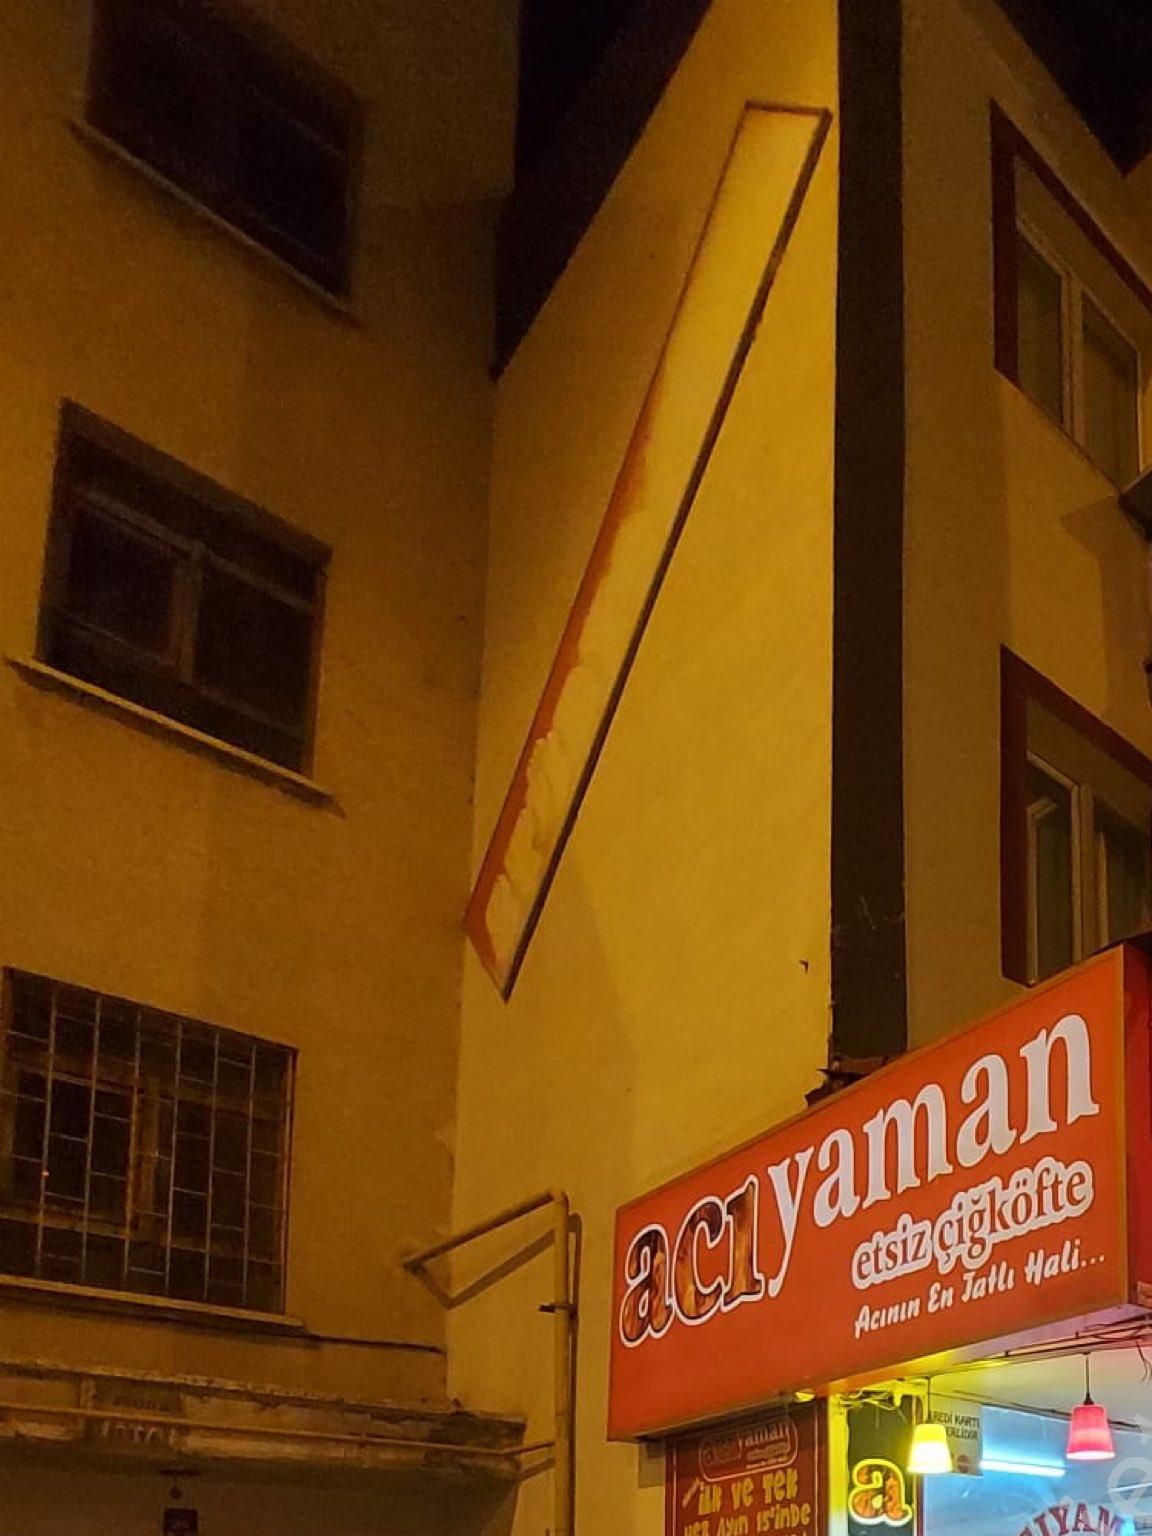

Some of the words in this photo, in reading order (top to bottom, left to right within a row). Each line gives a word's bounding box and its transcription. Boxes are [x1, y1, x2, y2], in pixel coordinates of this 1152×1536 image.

[854, 1217, 932, 1287] etsiz
[934, 1159, 1093, 1271] çiğköfte
[854, 1305, 921, 1339] Acının
[927, 1282, 953, 1313] En
